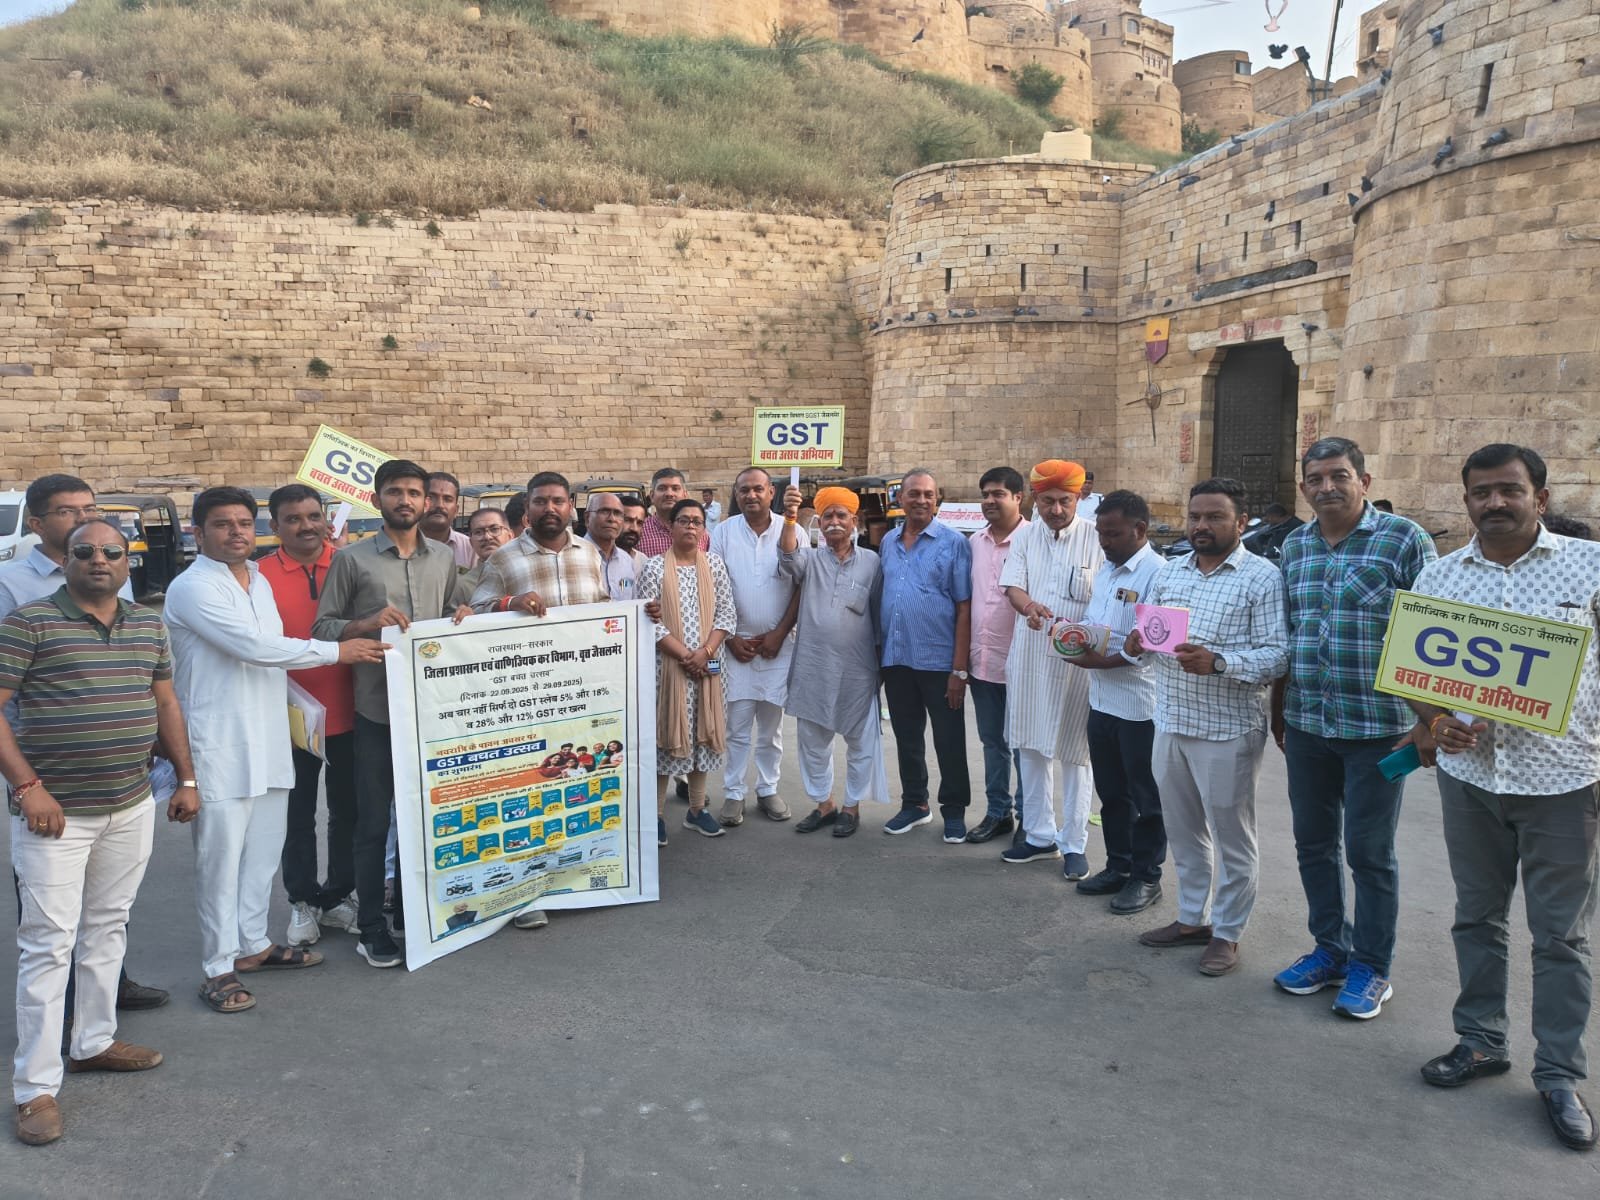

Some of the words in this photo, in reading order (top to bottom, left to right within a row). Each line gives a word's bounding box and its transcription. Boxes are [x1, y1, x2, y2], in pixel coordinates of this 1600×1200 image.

[767, 422, 829, 446] GST
[760, 449, 777, 460] बचत
[778, 449, 799, 460] उत्सव
[800, 446, 834, 460] अभियान
[325, 449, 376, 486] GS
[309, 467, 332, 486] बचत
[331, 477, 358, 497] उत्सव
[1402, 602, 1449, 620] वाणिज्यिक
[1451, 612, 1465, 624] कर
[1468, 613, 1500, 630] विभाग
[1501, 622, 1535, 638] SGST
[1537, 627, 1579, 647] जैसलमेर
[423, 665, 447, 680] जिला
[449, 662, 480, 677] प्रशासन
[481, 657, 493, 672] एवं
[494, 655, 536, 672] वाणिज्यिक
[537, 653, 550, 664] कर
[551, 650, 578, 664] विभाग,
[591, 644, 622, 658] जैसलमेर
[1414, 626, 1551, 687] GST
[490, 685, 529, 697] 22.09.2025
[532, 682, 539, 691] से
[543, 676, 583, 690] 29.09.2025)
[1394, 667, 1432, 690] बचत
[1432, 675, 1477, 702] उत्सव
[1477, 686, 1552, 720] अभियान
[438, 711, 454, 720] अब
[456, 708, 471, 717] चार
[472, 704, 487, 715] नहीं
[489, 701, 508, 712] सिर्फ
[508, 700, 517, 709] दो
[519, 698, 537, 708] GST
[560, 693, 573, 701] 5%
[576, 688, 590, 699] और
[593, 687, 610, 697] 18%
[466, 721, 473, 729] व
[475, 717, 495, 728] 28%
[498, 714, 514, 724] और
[517, 711, 534, 721] 12%
[536, 708, 555, 718] GST
[558, 707, 567, 715] दर
[569, 703, 587, 713] खत्म
[436, 756, 464, 768] GST
[467, 750, 500, 762] बचत
[503, 741, 541, 755] उत्सव
[469, 742, 477, 751] के
[478, 739, 500, 749] पावन
[527, 733, 537, 741] पर
[438, 769, 449, 777] का
